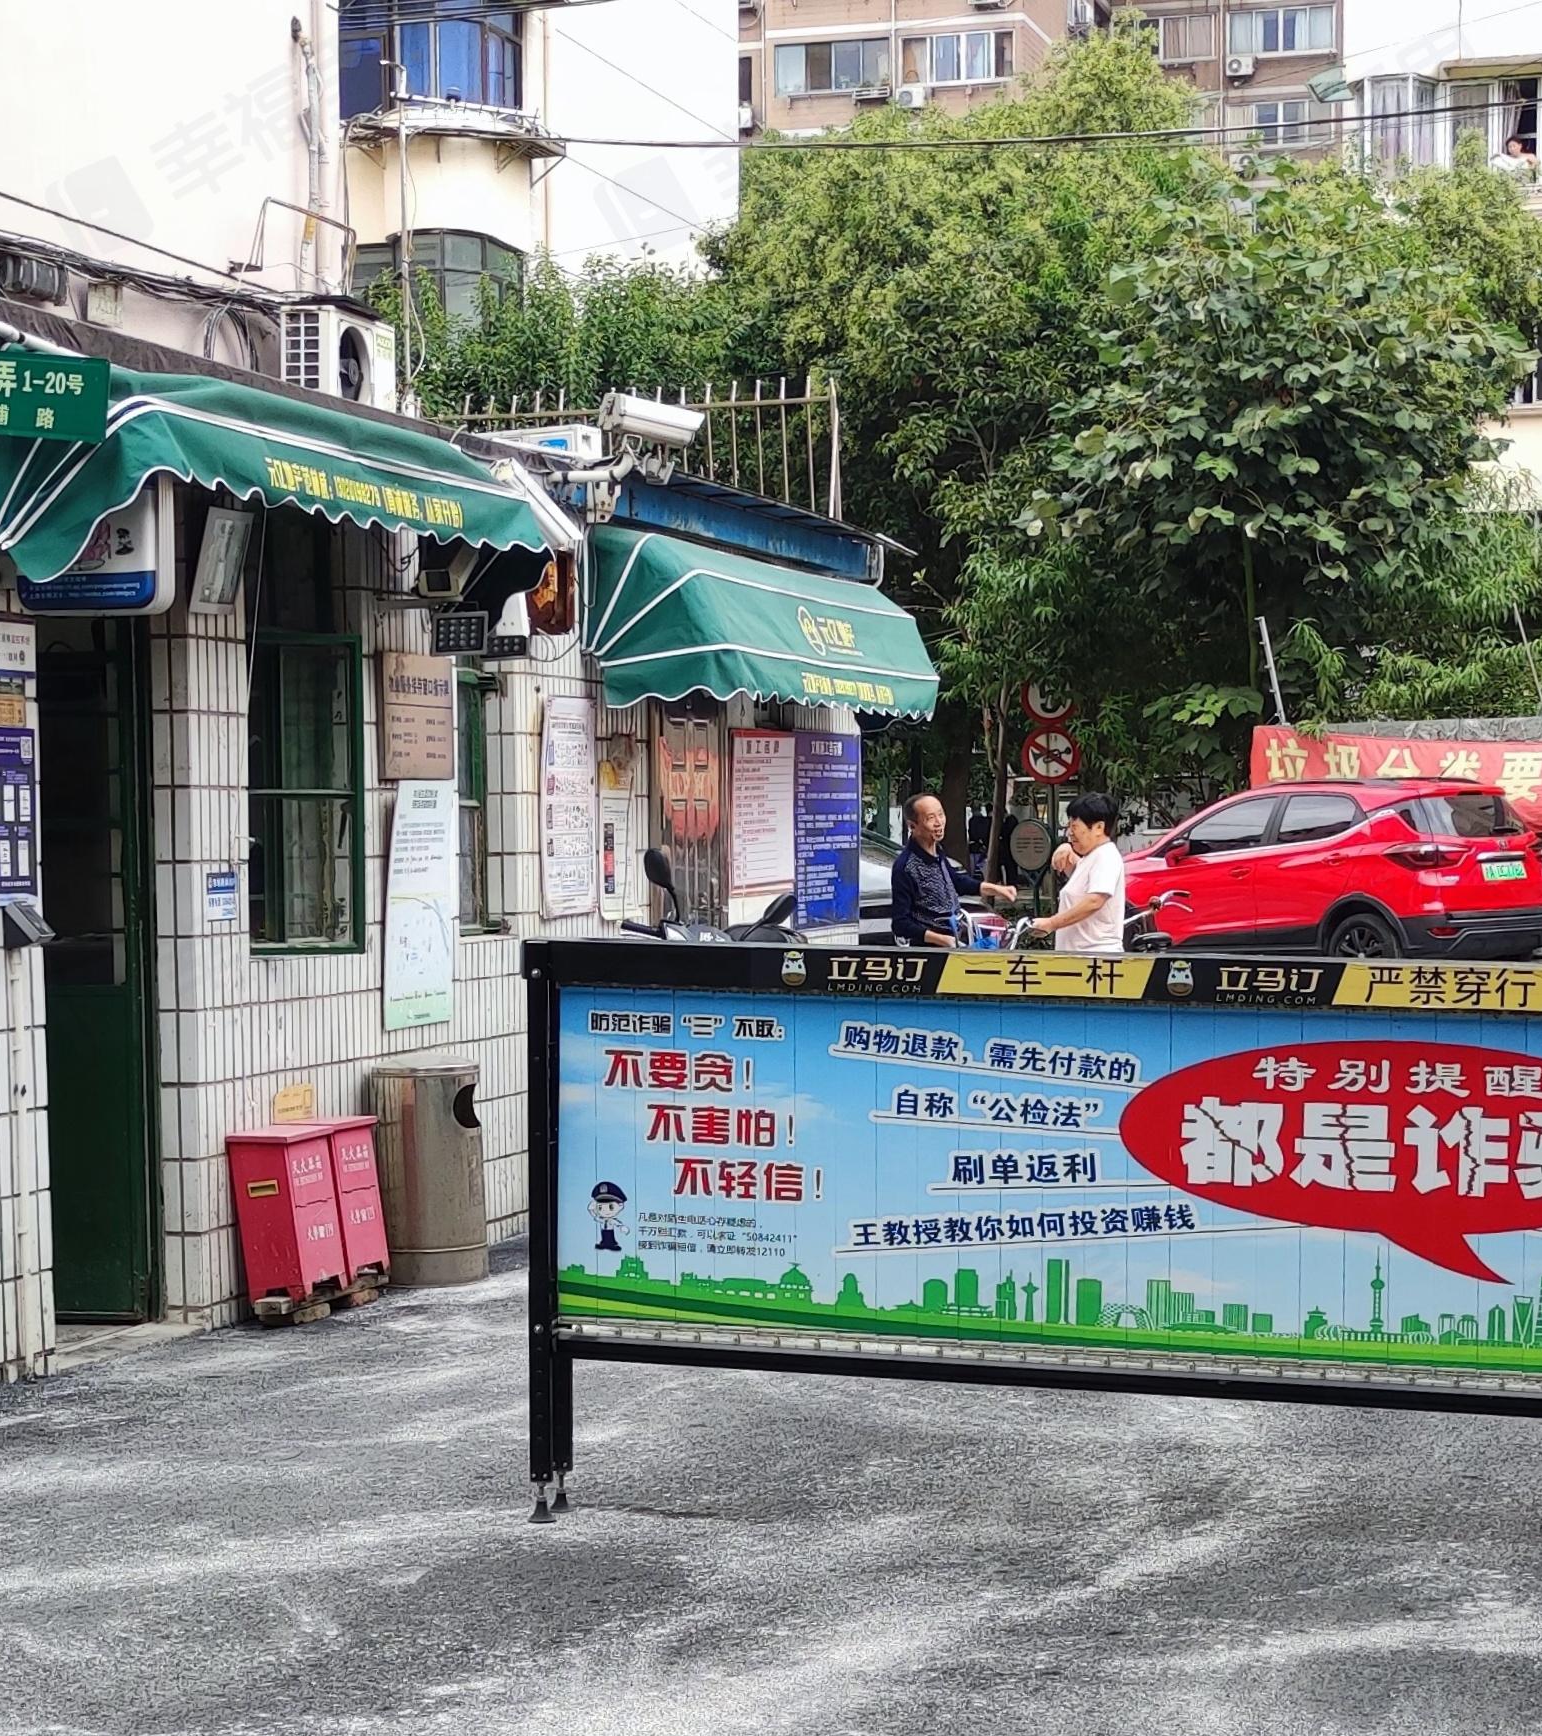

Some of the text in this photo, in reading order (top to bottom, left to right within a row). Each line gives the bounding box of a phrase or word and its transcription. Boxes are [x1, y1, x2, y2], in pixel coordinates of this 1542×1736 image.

[827, 956, 929, 981] 立马订
[963, 955, 1125, 995] 一车一杆
[1217, 967, 1325, 993] 立马订
[1365, 966, 1538, 1009] 严禁穿行
[842, 1024, 1138, 1084] 购物退款，需先付款的
[951, 1153, 1098, 1185] 刷单返利
[851, 1203, 1197, 1248] 王教授教你如何投资赚钱
